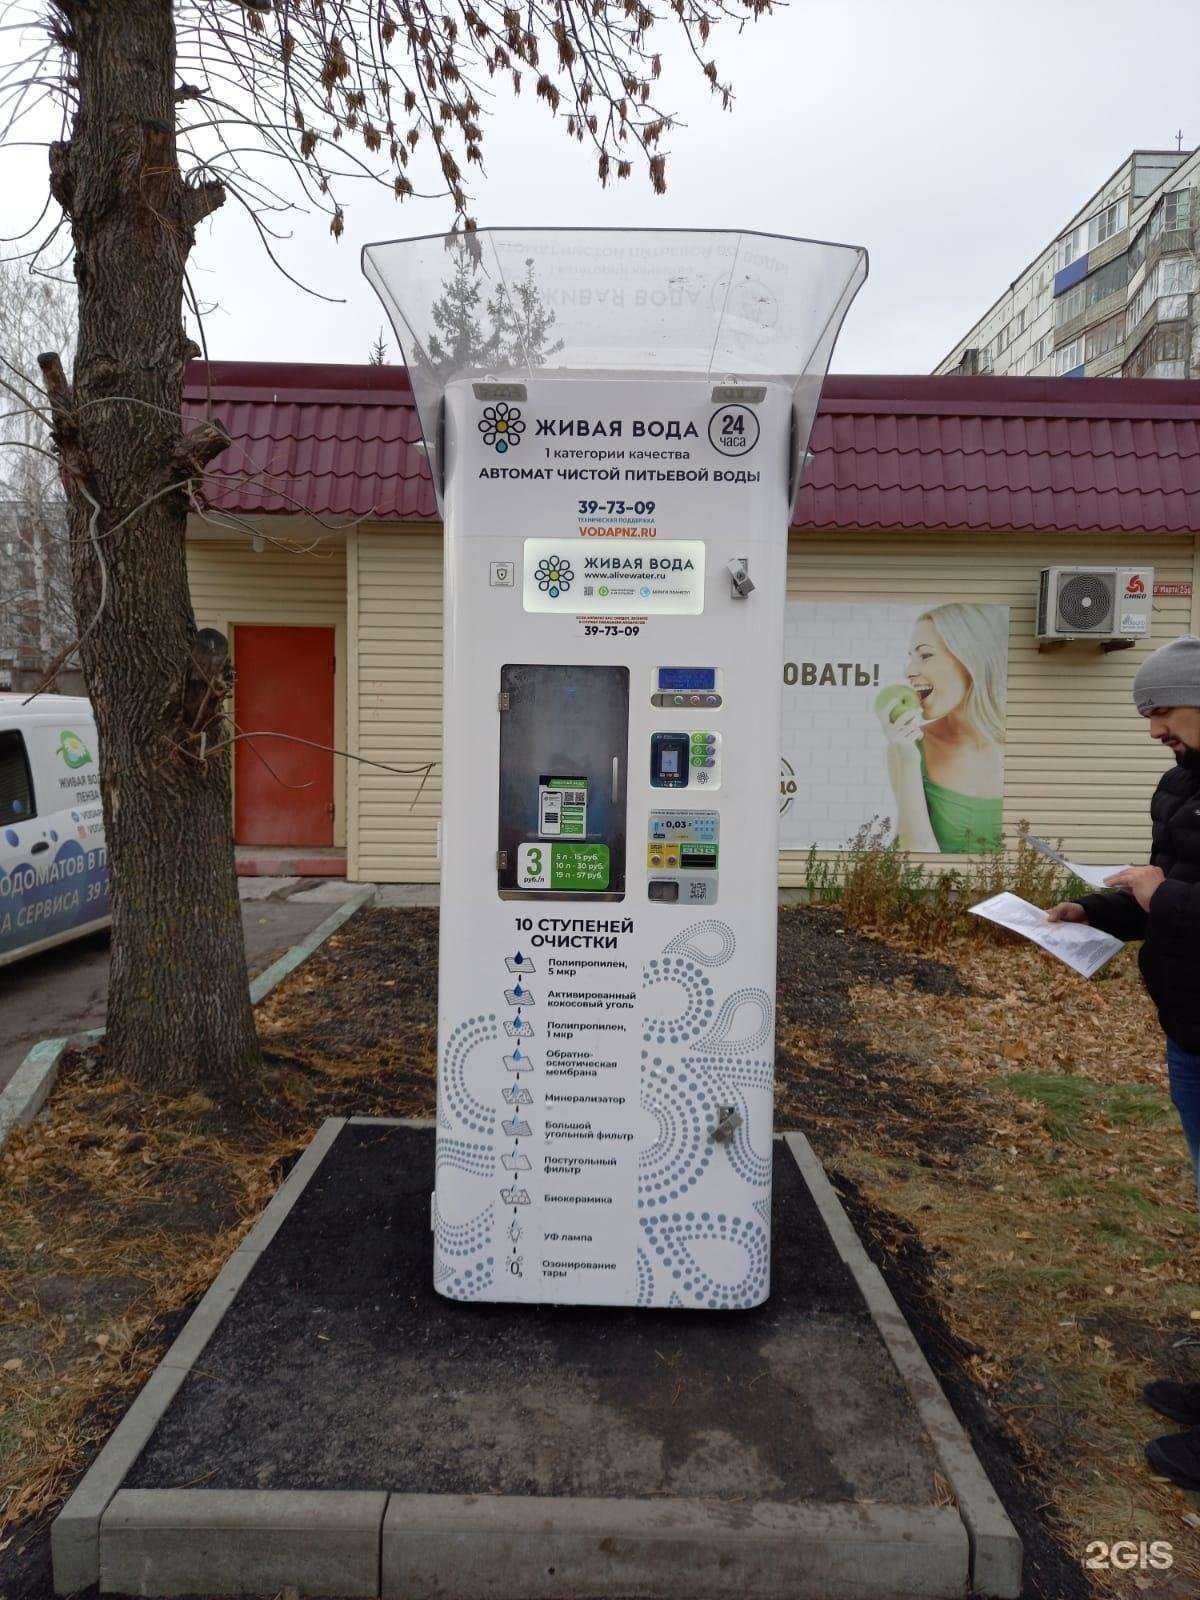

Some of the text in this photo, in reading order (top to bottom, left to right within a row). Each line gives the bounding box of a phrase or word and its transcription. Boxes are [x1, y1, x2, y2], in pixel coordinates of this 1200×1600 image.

[535, 419, 699, 440] ЖИВАЯ ВОДА
[721, 414, 745, 435] 24
[719, 436, 746, 447] часа
[545, 447, 690, 461] 1 категории качества
[479, 466, 760, 484] АВТОМАТ ЧИСТОЙ ПИТЬЕВОЙ ВОДЫ
[578, 500, 656, 515] 39-73-09
[579, 526, 657, 538] VODAPNZ.RU
[583, 557, 695, 571] ЖИВАЯ ВОДА
[584, 571, 666, 580] www.alivewater.ru
[584, 626, 640, 637] 39-73-09
[783, 662, 880, 687] ОВАТЬ!
[58, 774, 86, 788] ЖИВАЯ
[76, 789, 101, 802] ПЕНЗА
[666, 820, 687, 829] 0,03
[526, 847, 543, 876] 3
[0, 855, 85, 898] ОДОМАТОВ
[576, 871, 586, 879] 57
[16, 888, 81, 928] СЕРВИСА
[86, 880, 101, 902] 39
[515, 917, 634, 933] 10 СТУПЕНЕЙ
[531, 934, 618, 949] ОЧИСТКИ
[548, 958, 628, 969] Полипропилен,
[548, 968, 577, 977] 5 мкр
[547, 990, 637, 1001] Активированный
[547, 1000, 634, 1010] кокосовый уголь
[547, 1021, 627, 1032] Полипропилен,
[547, 1030, 574, 1039] 1 мкр
[546, 1050, 594, 1059] Обратно-
[546, 1060, 618, 1068] осмотическая
[546, 1068, 597, 1077] мембрана
[545, 1094, 626, 1105] Минерализатор
[545, 1120, 592, 1130] Большой
[545, 1130, 634, 1141] угольный фильтр
[544, 1156, 617, 1167] Постугольный
[544, 1166, 581, 1174] фильтр
[544, 1194, 613, 1204] Биокерамика
[561, 1234, 593, 1242] лампа
[542, 1260, 617, 1271] Озонирование
[542, 1269, 568, 1278] тары
